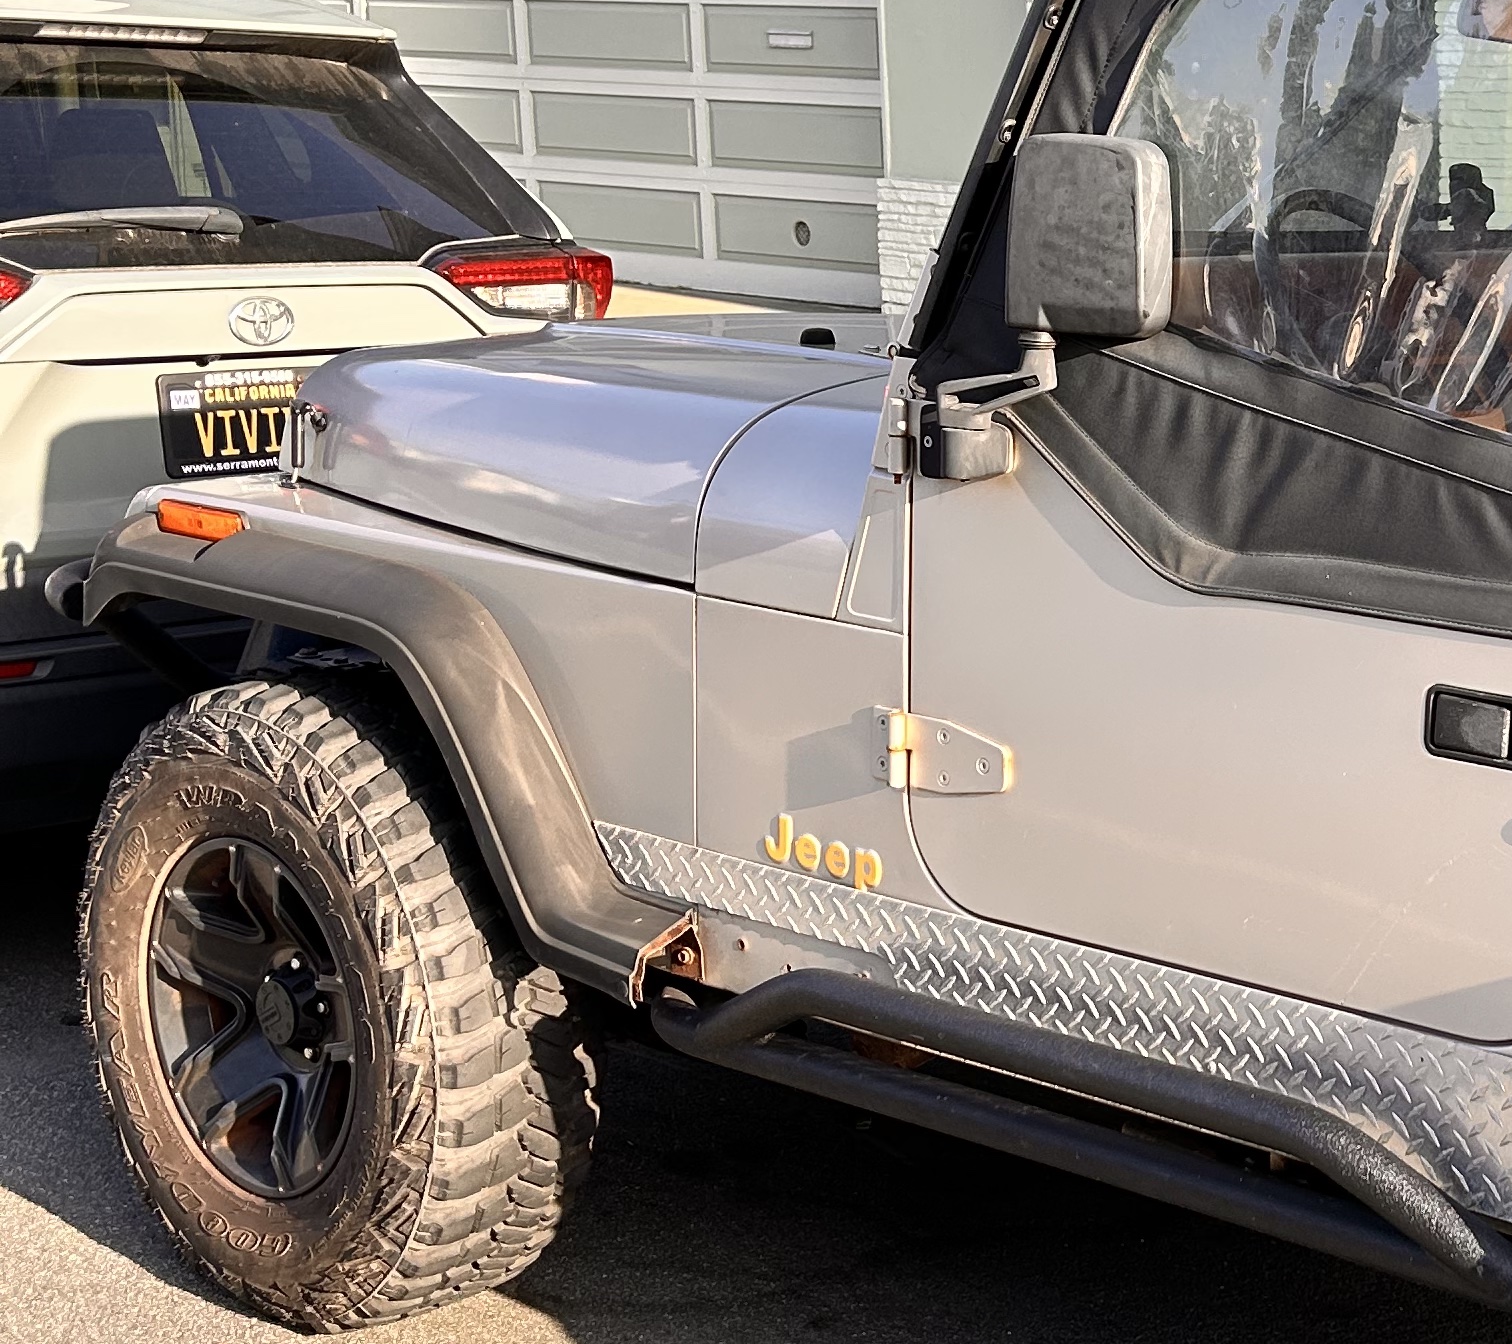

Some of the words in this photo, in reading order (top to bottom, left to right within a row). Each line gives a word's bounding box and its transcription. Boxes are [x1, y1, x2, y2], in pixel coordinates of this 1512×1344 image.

[174, 394, 196, 406] MAY
[204, 384, 296, 403] CALIFORNIA
[181, 456, 280, 474] www.serramont
[764, 812, 883, 893] Jeep
[99, 970, 294, 1259] GOODYEAR
